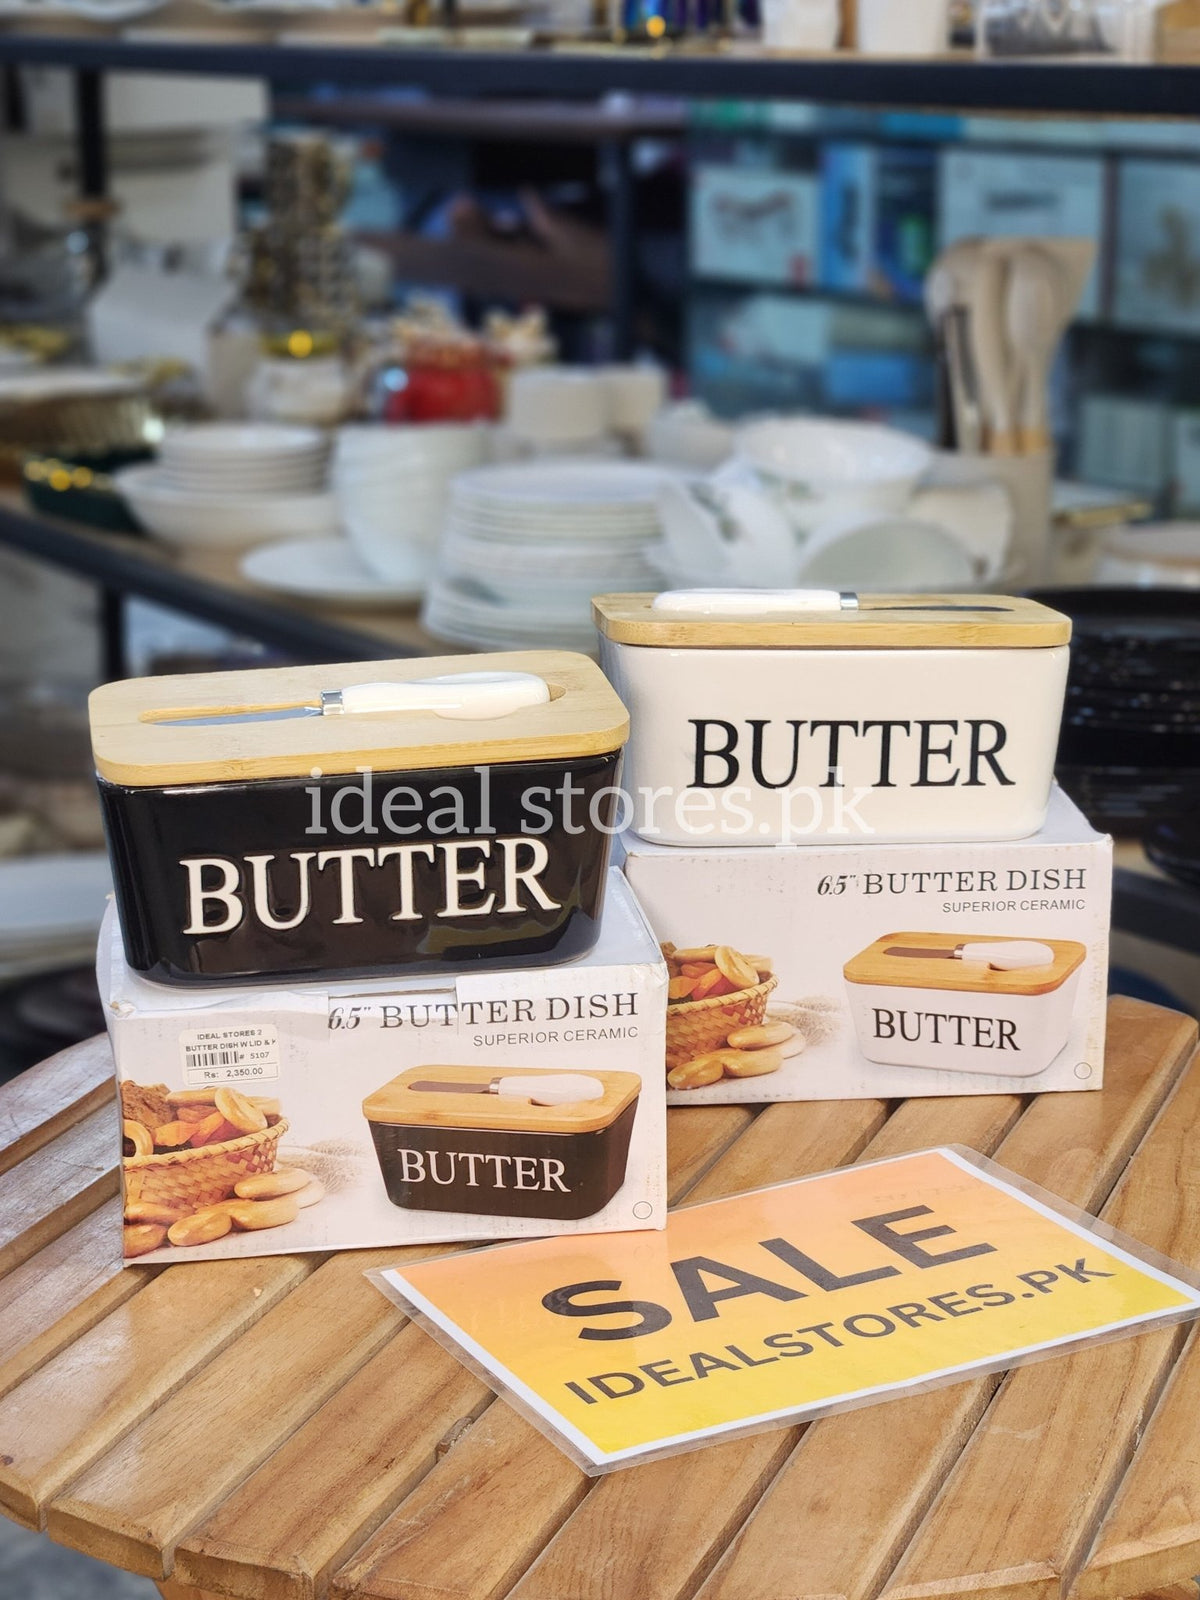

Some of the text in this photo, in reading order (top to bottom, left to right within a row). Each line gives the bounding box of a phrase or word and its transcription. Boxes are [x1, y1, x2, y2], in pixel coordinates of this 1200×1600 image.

[686, 719, 1016, 789] BUTTER
[179, 838, 562, 935] BUTTER
[862, 870, 998, 895] BUTTER
[1006, 868, 1087, 891] DISH
[942, 899, 1086, 913] SUPERIOR CERAMIC
[379, 999, 536, 1029] BUTTER
[545, 992, 639, 1021] DISH
[197, 1033, 220, 1041] IDEAL
[222, 1029, 256, 1039] STORES
[473, 1026, 639, 1047] SUPERIOR CERAMIC
[872, 1008, 1021, 1051] BUTTER
[185, 1043, 218, 1052] BUTTER
[219, 1041, 239, 1050] DISH
[250, 1051, 270, 1060] 5107
[226, 1067, 263, 1078] 2,350.00
[397, 1148, 572, 1193] BUTTER
[541, 1204, 998, 1341] SALE
[563, 1257, 1116, 1405] IDEALSTORES.PK
